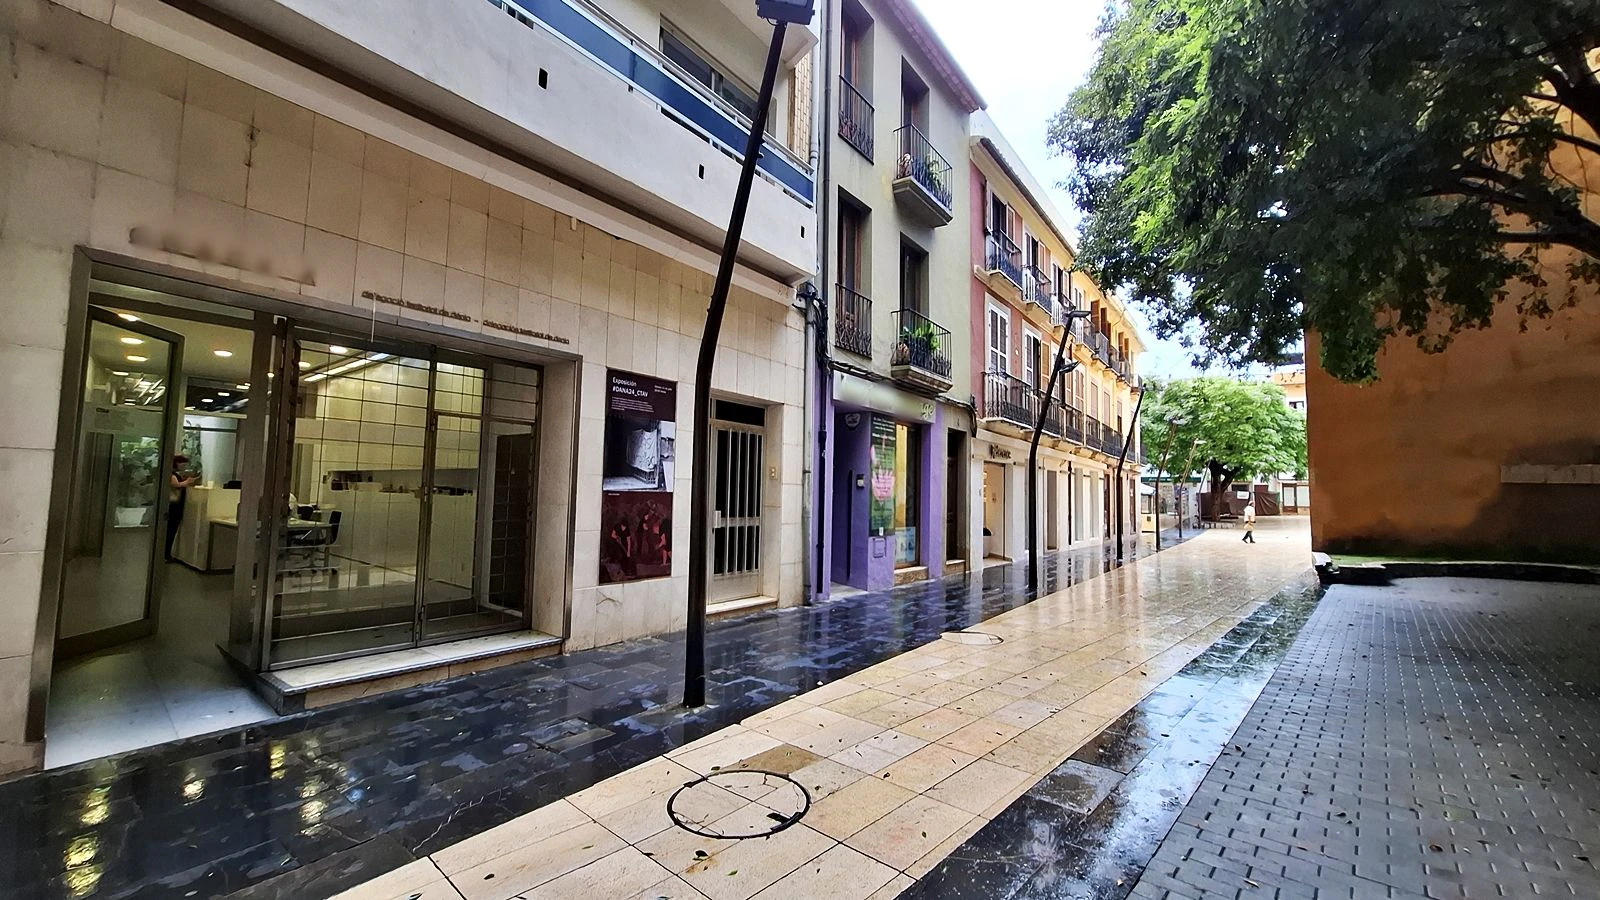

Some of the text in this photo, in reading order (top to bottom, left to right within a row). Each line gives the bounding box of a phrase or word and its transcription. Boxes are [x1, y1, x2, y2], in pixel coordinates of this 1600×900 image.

[406, 300, 438, 315] territorial
[438, 308, 450, 317] de
[612, 376, 637, 387] Exposición
[612, 385, 649, 397] #DANA24_CTAV
